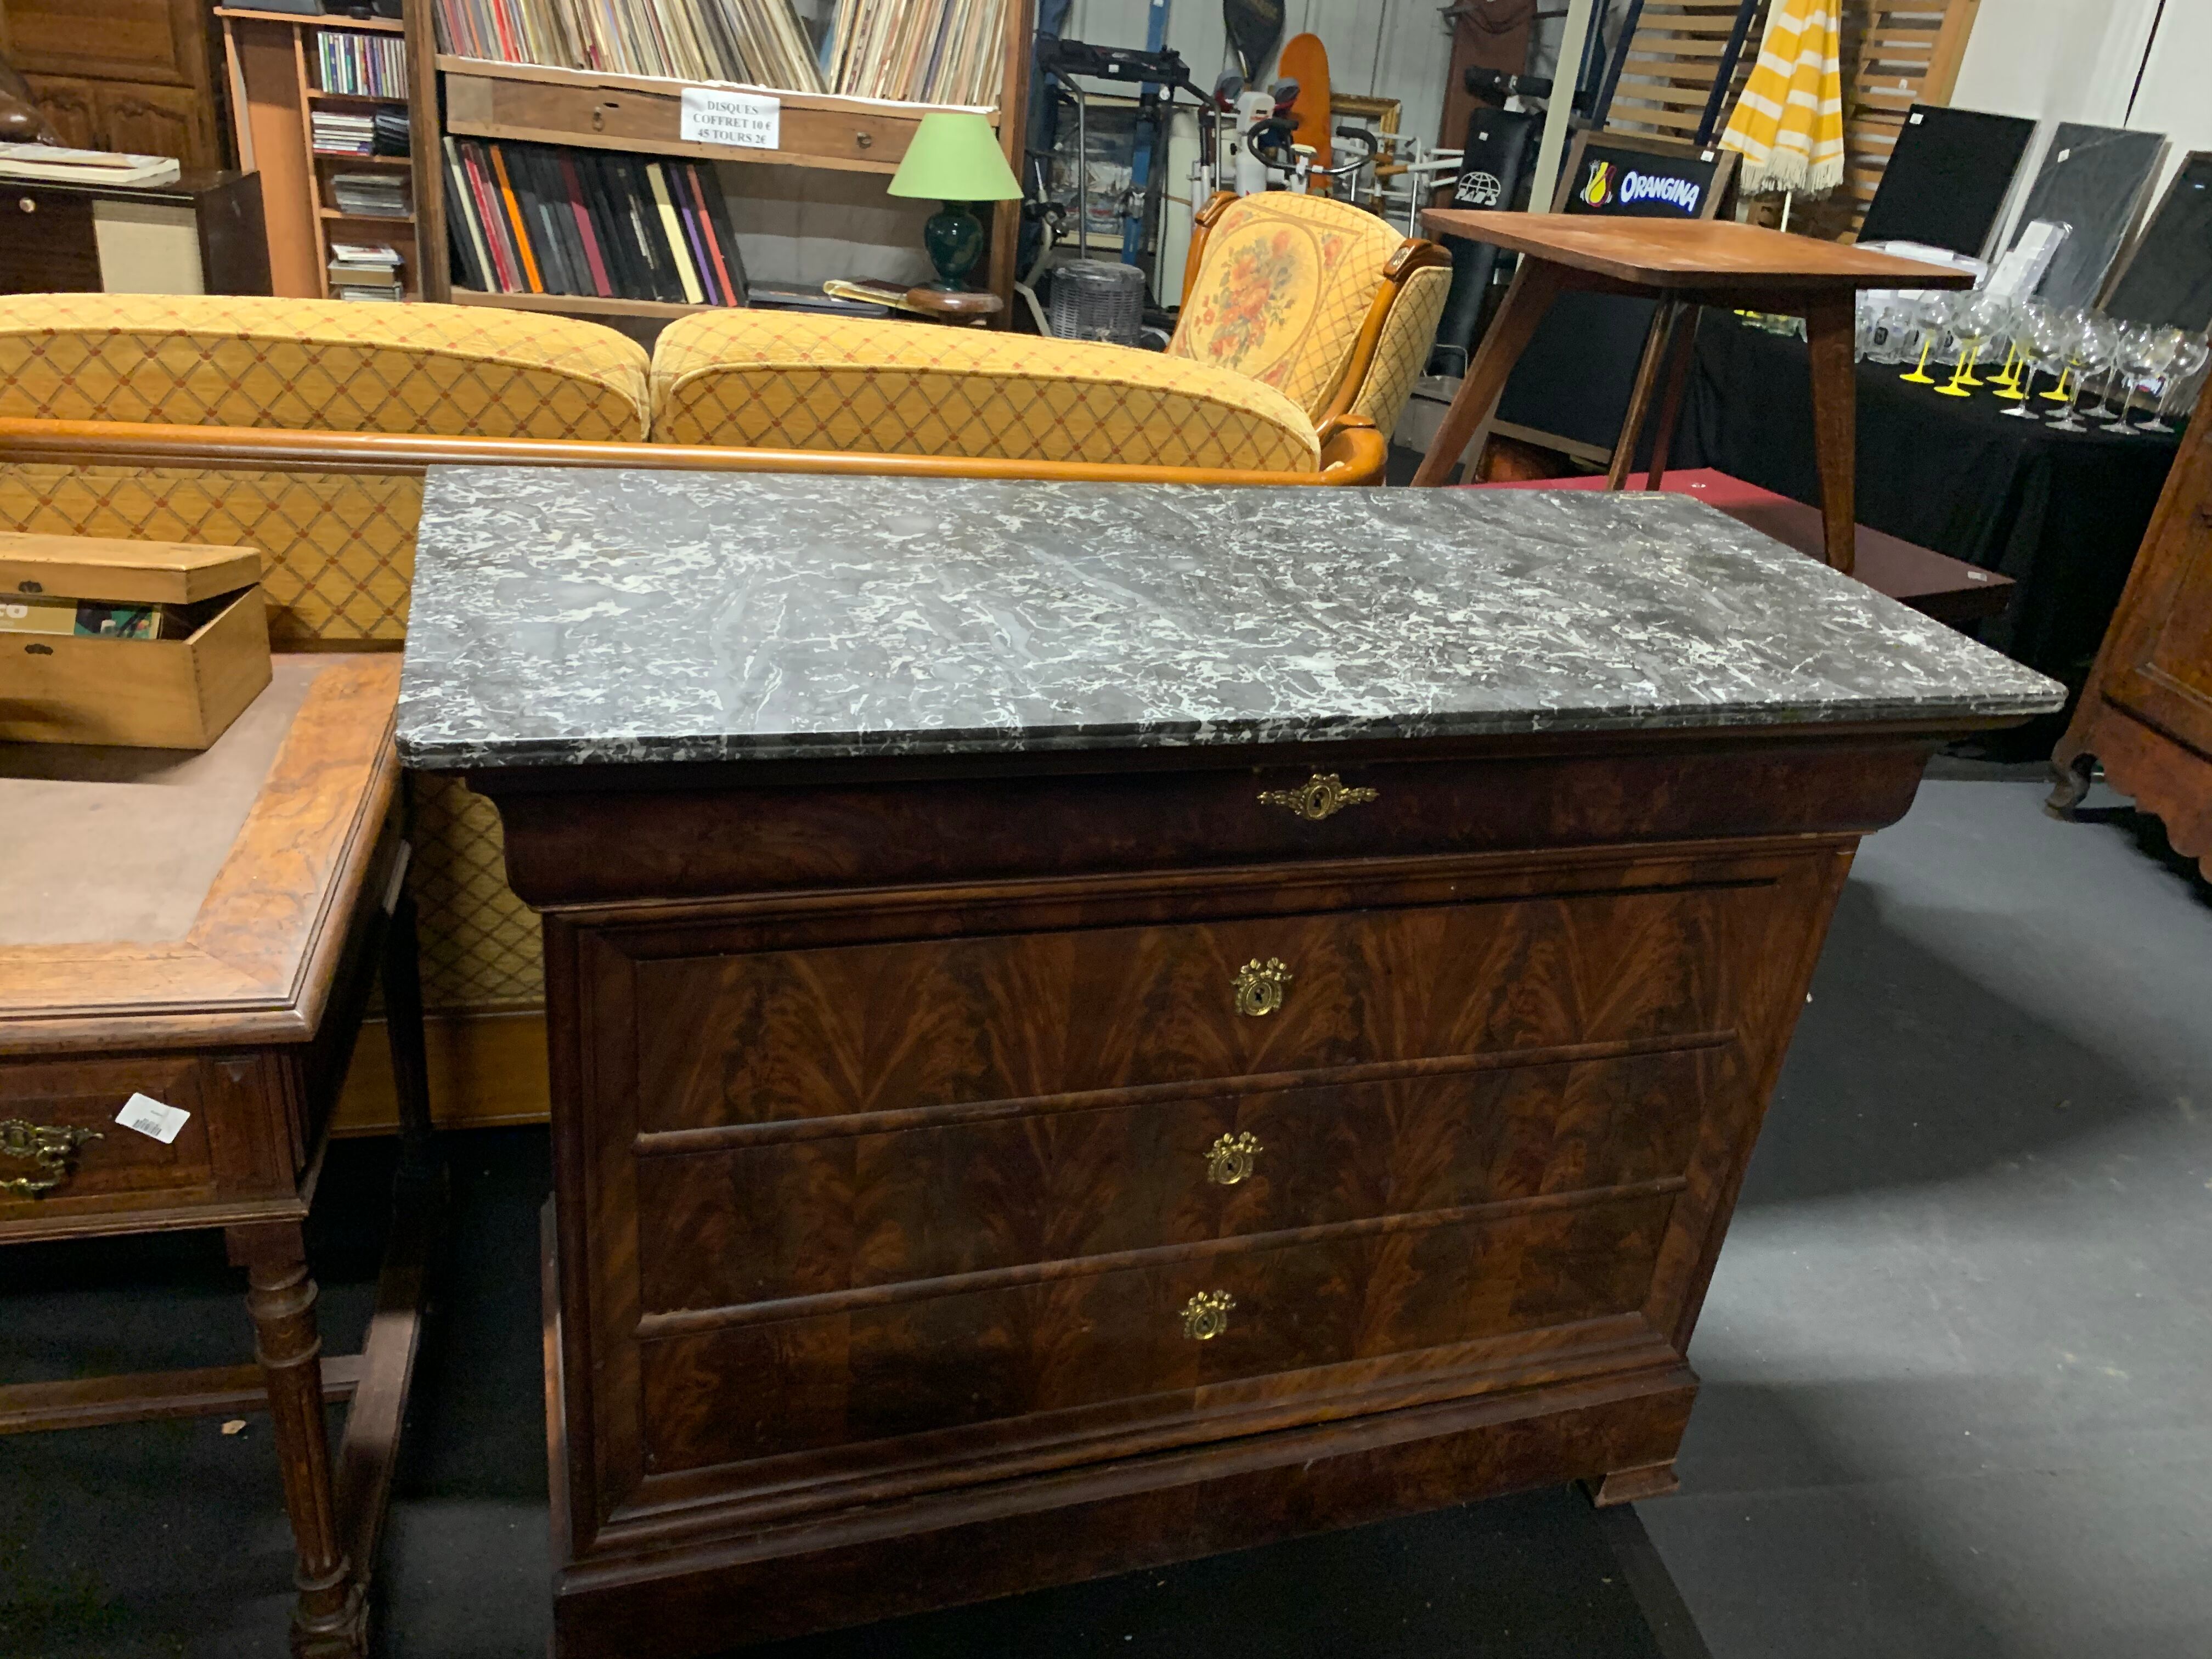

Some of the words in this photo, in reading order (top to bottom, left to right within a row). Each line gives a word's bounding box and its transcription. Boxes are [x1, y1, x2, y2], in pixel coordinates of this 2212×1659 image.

[707, 100, 759, 115] DISQUES
[693, 113, 748, 128] COFFRET
[752, 120, 763, 130] 10
[765, 121, 772, 131] €
[698, 129, 710, 137] 45
[713, 129, 752, 143] TOURS
[755, 134, 768, 144] 2€
[1620, 171, 1700, 212] ORANGINA
